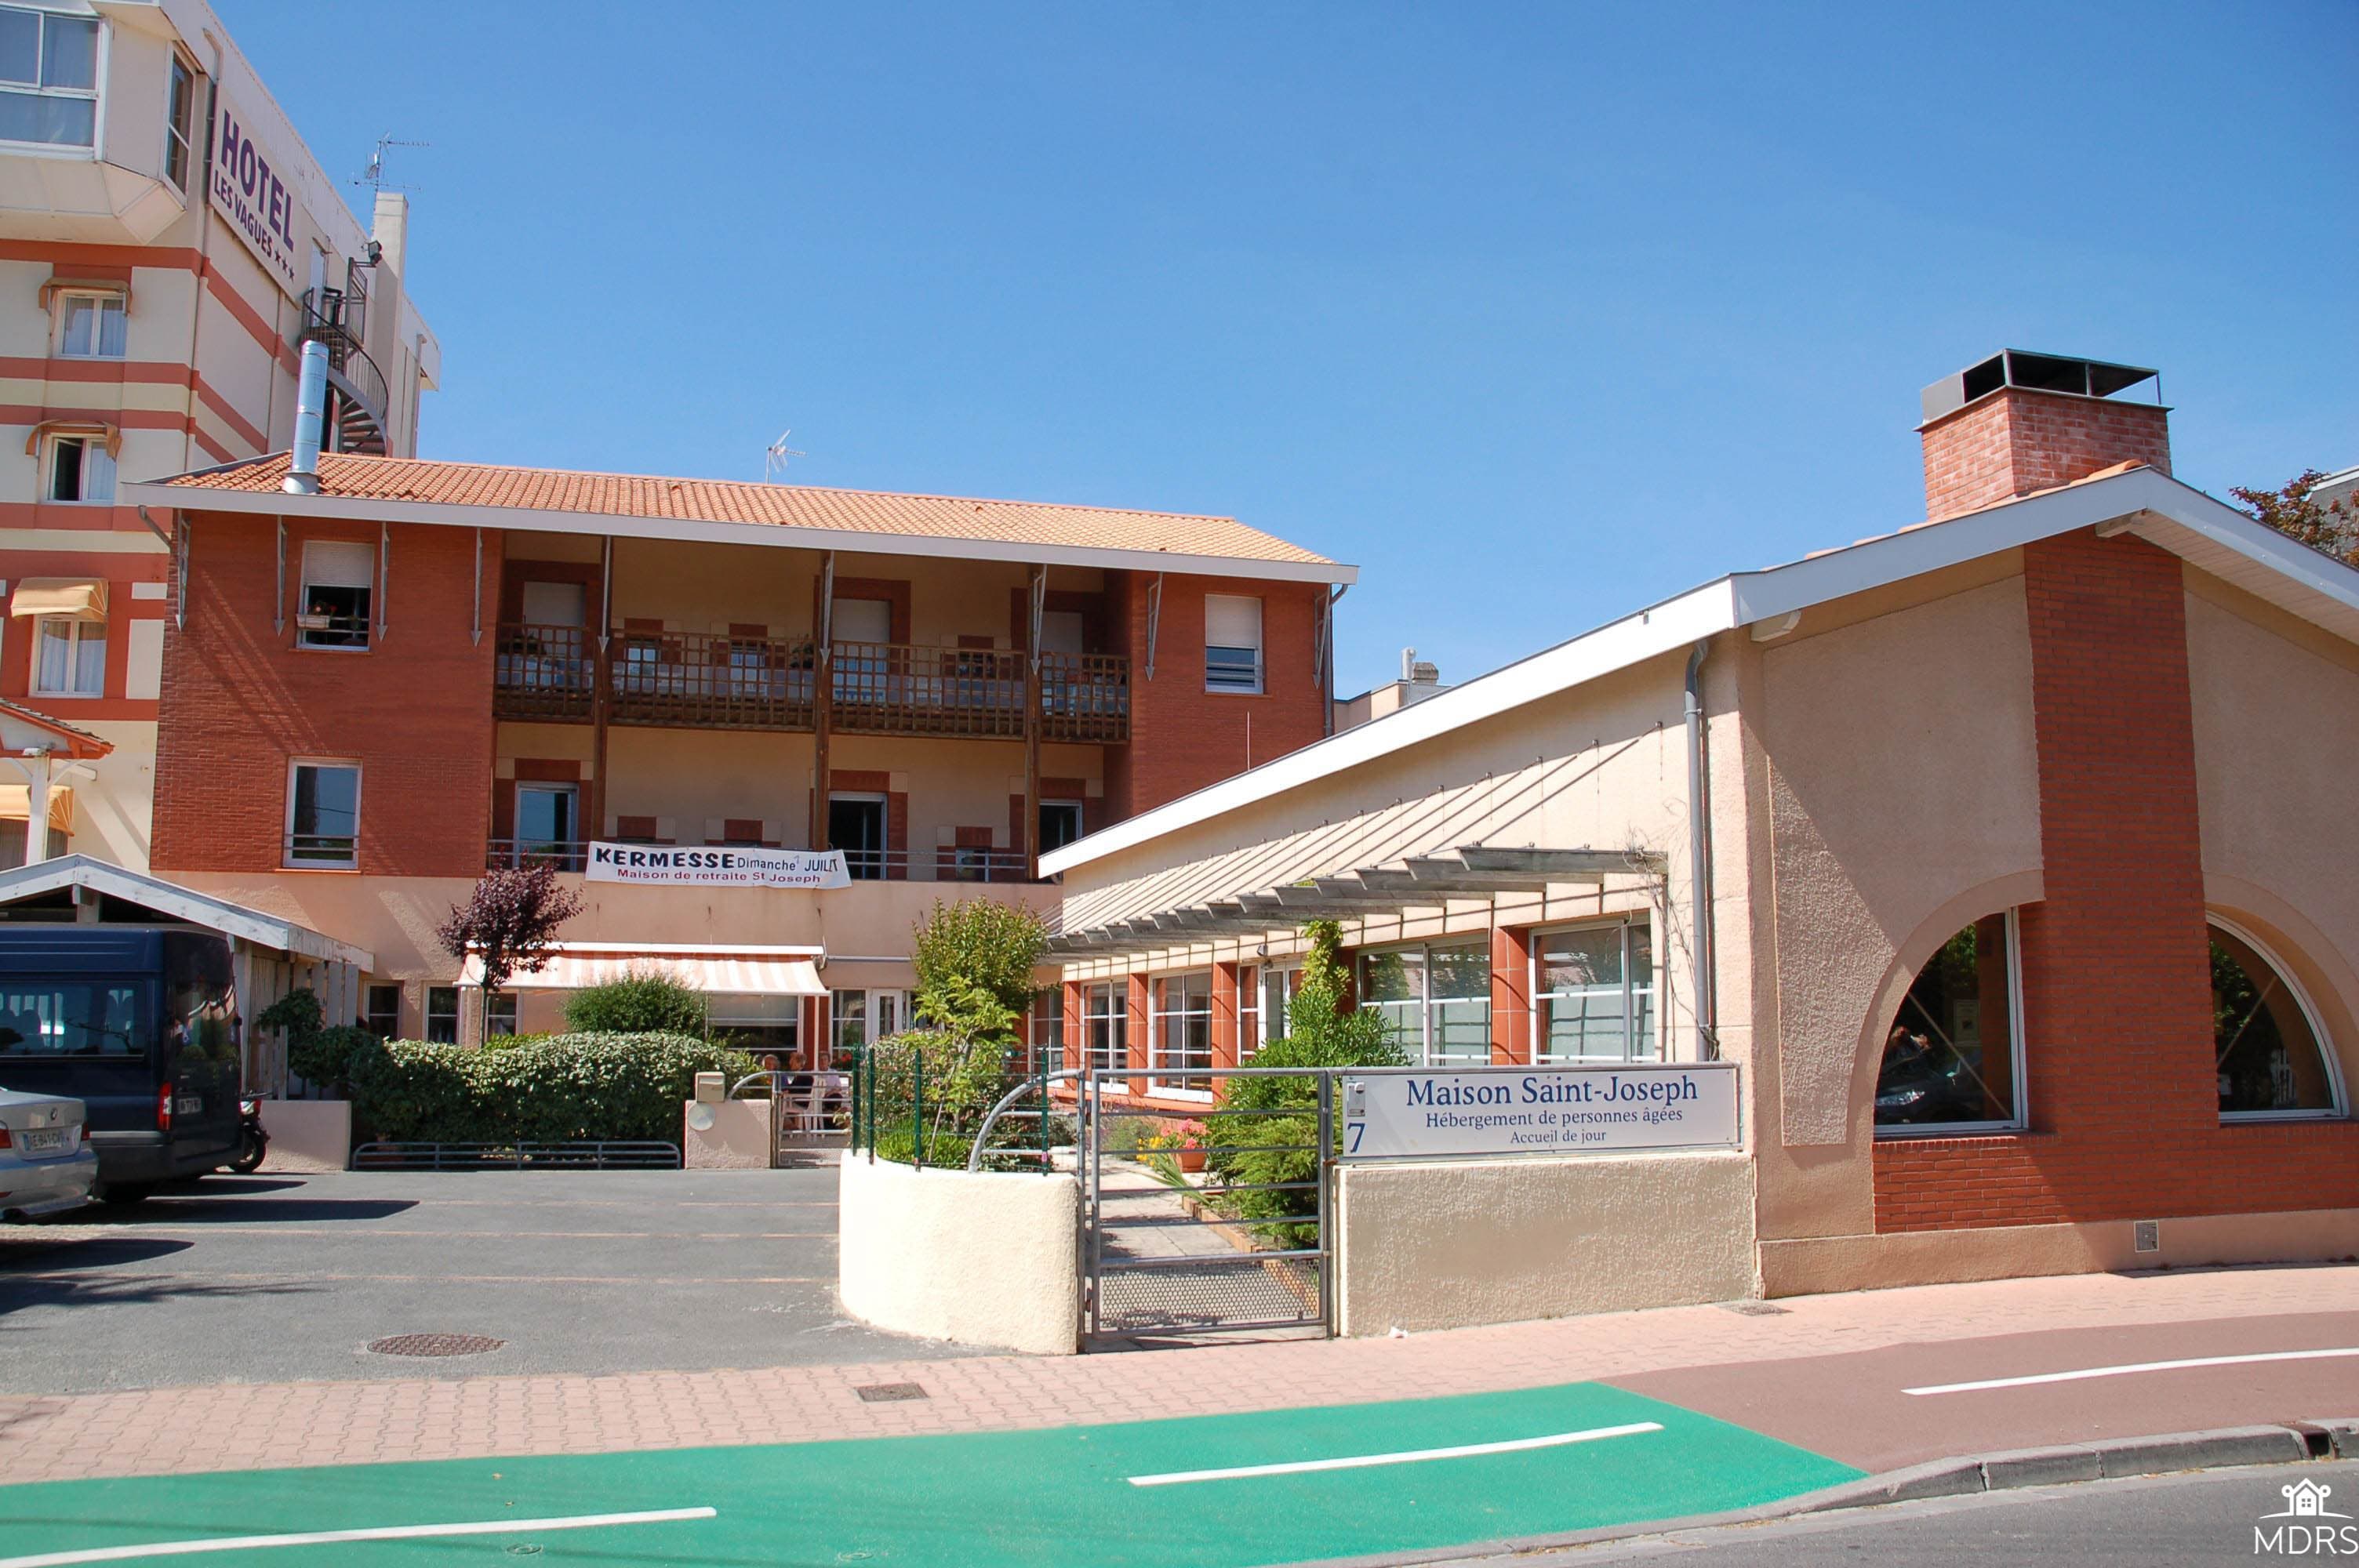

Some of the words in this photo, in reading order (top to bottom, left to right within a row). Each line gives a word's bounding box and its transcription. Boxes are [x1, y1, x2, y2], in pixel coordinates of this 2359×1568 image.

[221, 108, 294, 253] HOTEL
[214, 169, 234, 210] LES
[234, 194, 273, 259] VAGUES
[596, 848, 735, 869] KERMESSE
[737, 857, 796, 872] Dimanche
[617, 869, 669, 880] Maison
[674, 871, 691, 880] de
[696, 872, 747, 881] retraite
[753, 872, 765, 880] St
[769, 873, 820, 884] Joseph
[1406, 1078, 1512, 1106] Maison
[1521, 1075, 1699, 1106] Saint-Joseph
[1426, 1110, 1533, 1131] Hébergement
[1538, 1109, 1557, 1125] de
[1561, 1109, 1638, 1127] personnes
[1642, 1106, 1683, 1125] âgées
[1347, 1122, 1366, 1153] 7
[1510, 1129, 1558, 1144] Accueil
[1562, 1129, 1578, 1142] de
[1581, 1128, 1607, 1145] jour
